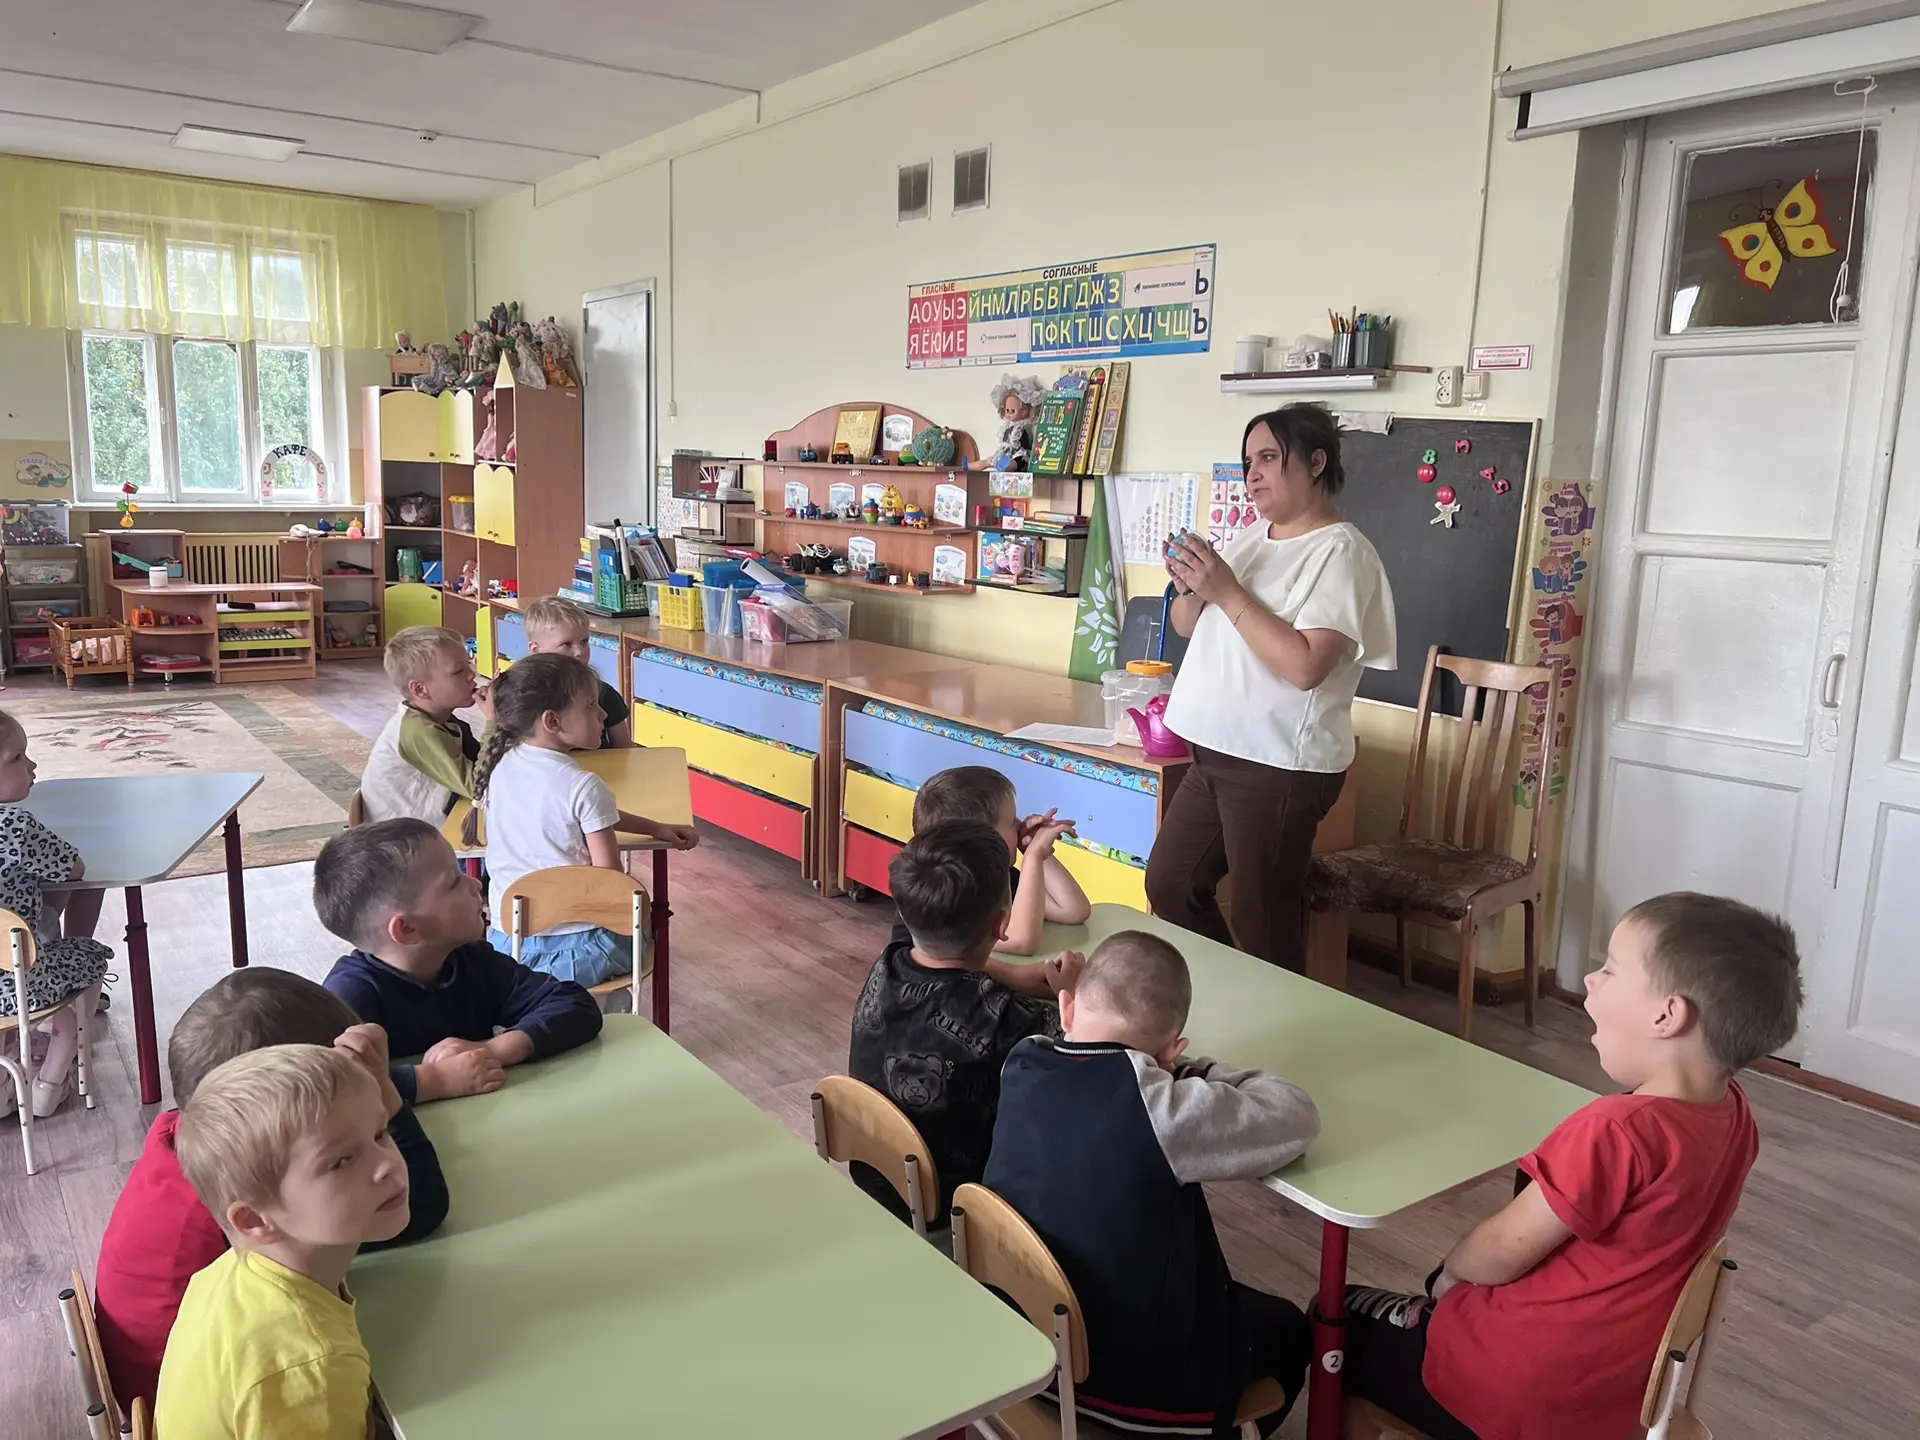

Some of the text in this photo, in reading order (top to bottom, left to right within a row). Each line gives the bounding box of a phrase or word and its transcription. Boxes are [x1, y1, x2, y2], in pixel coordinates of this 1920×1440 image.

[1043, 262, 1098, 279] СОГЛАСНЫЕ
[921, 282, 956, 295] ГЛАСНЫЕ
[1195, 268, 1209, 295] Ь
[1192, 308, 1208, 334] Ъ
[272, 444, 307, 459] КАФЕ
[1422, 449, 1438, 464] 8
[1330, 1354, 1339, 1368] 2
